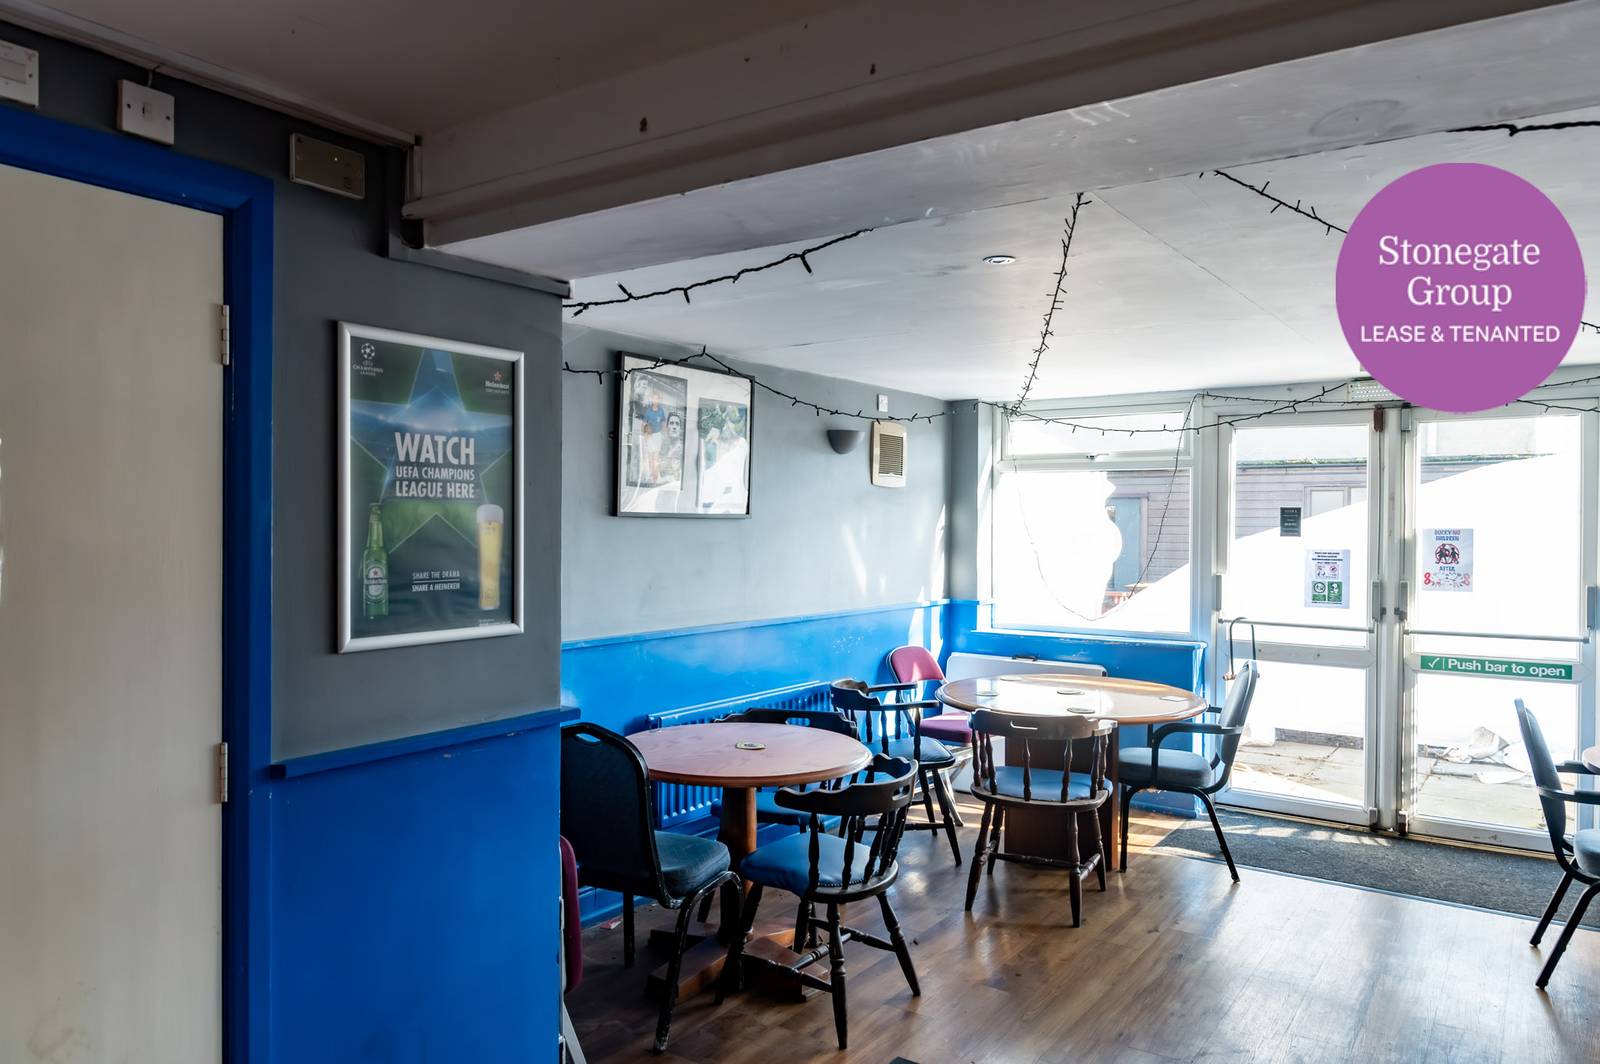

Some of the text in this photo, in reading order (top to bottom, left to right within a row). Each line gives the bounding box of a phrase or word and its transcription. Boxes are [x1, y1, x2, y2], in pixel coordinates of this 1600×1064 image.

[394, 431, 475, 466] WATCH
[395, 465, 476, 481] UEFA CHAMPIONS
[395, 480, 475, 499] LEAGUE HERE
[412, 571, 430, 580] SHARE
[431, 571, 440, 579] THE
[412, 584, 429, 592] SHARE
[1448, 658, 1566, 678] Push bar to open
